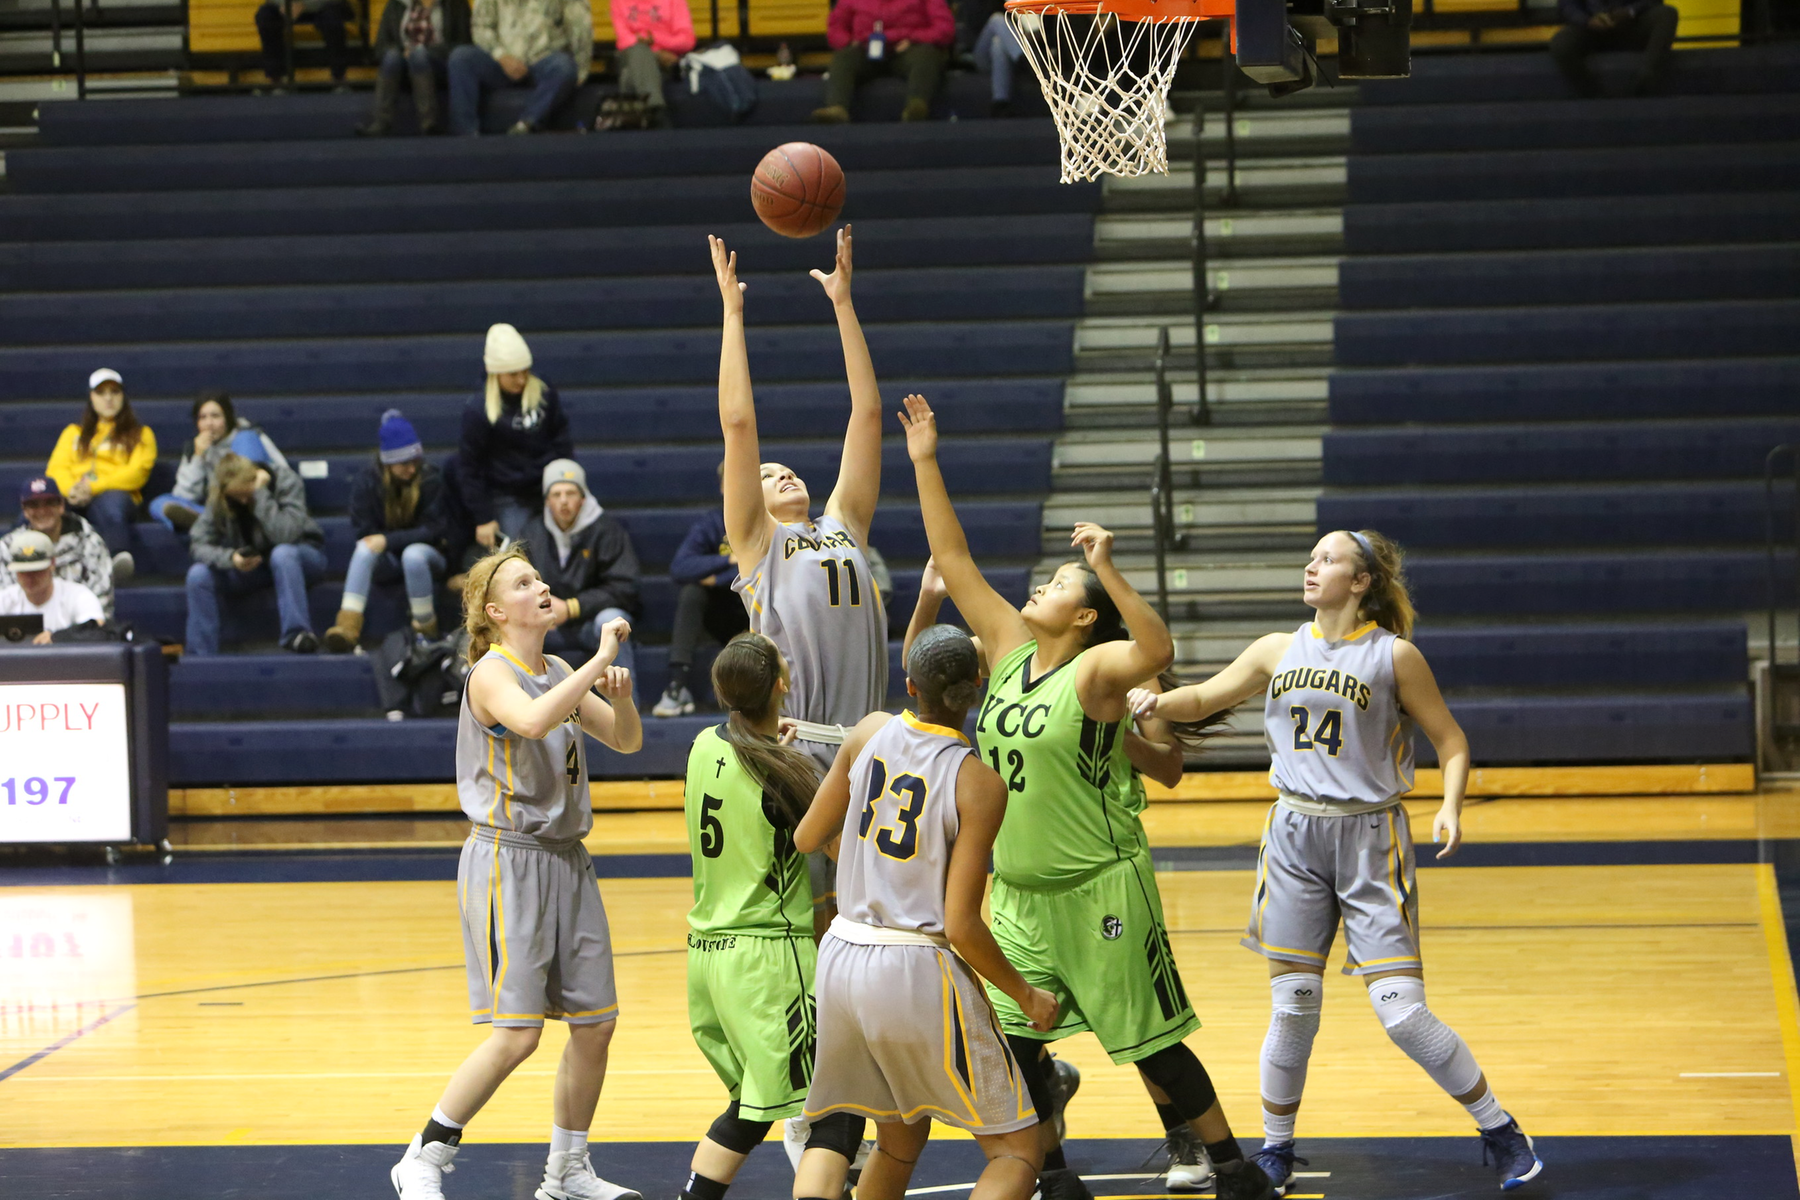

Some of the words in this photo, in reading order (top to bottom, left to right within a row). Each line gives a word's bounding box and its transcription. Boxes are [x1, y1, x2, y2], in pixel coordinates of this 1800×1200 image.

[820, 558, 861, 608] 11
[1271, 666, 1371, 712] COUGARS
[977, 694, 1052, 739] YCC
[1289, 704, 1344, 758] 24
[566, 738, 581, 786] 4
[988, 745, 1026, 793] 12
[1, 776, 77, 806] 197
[700, 792, 725, 859] 5
